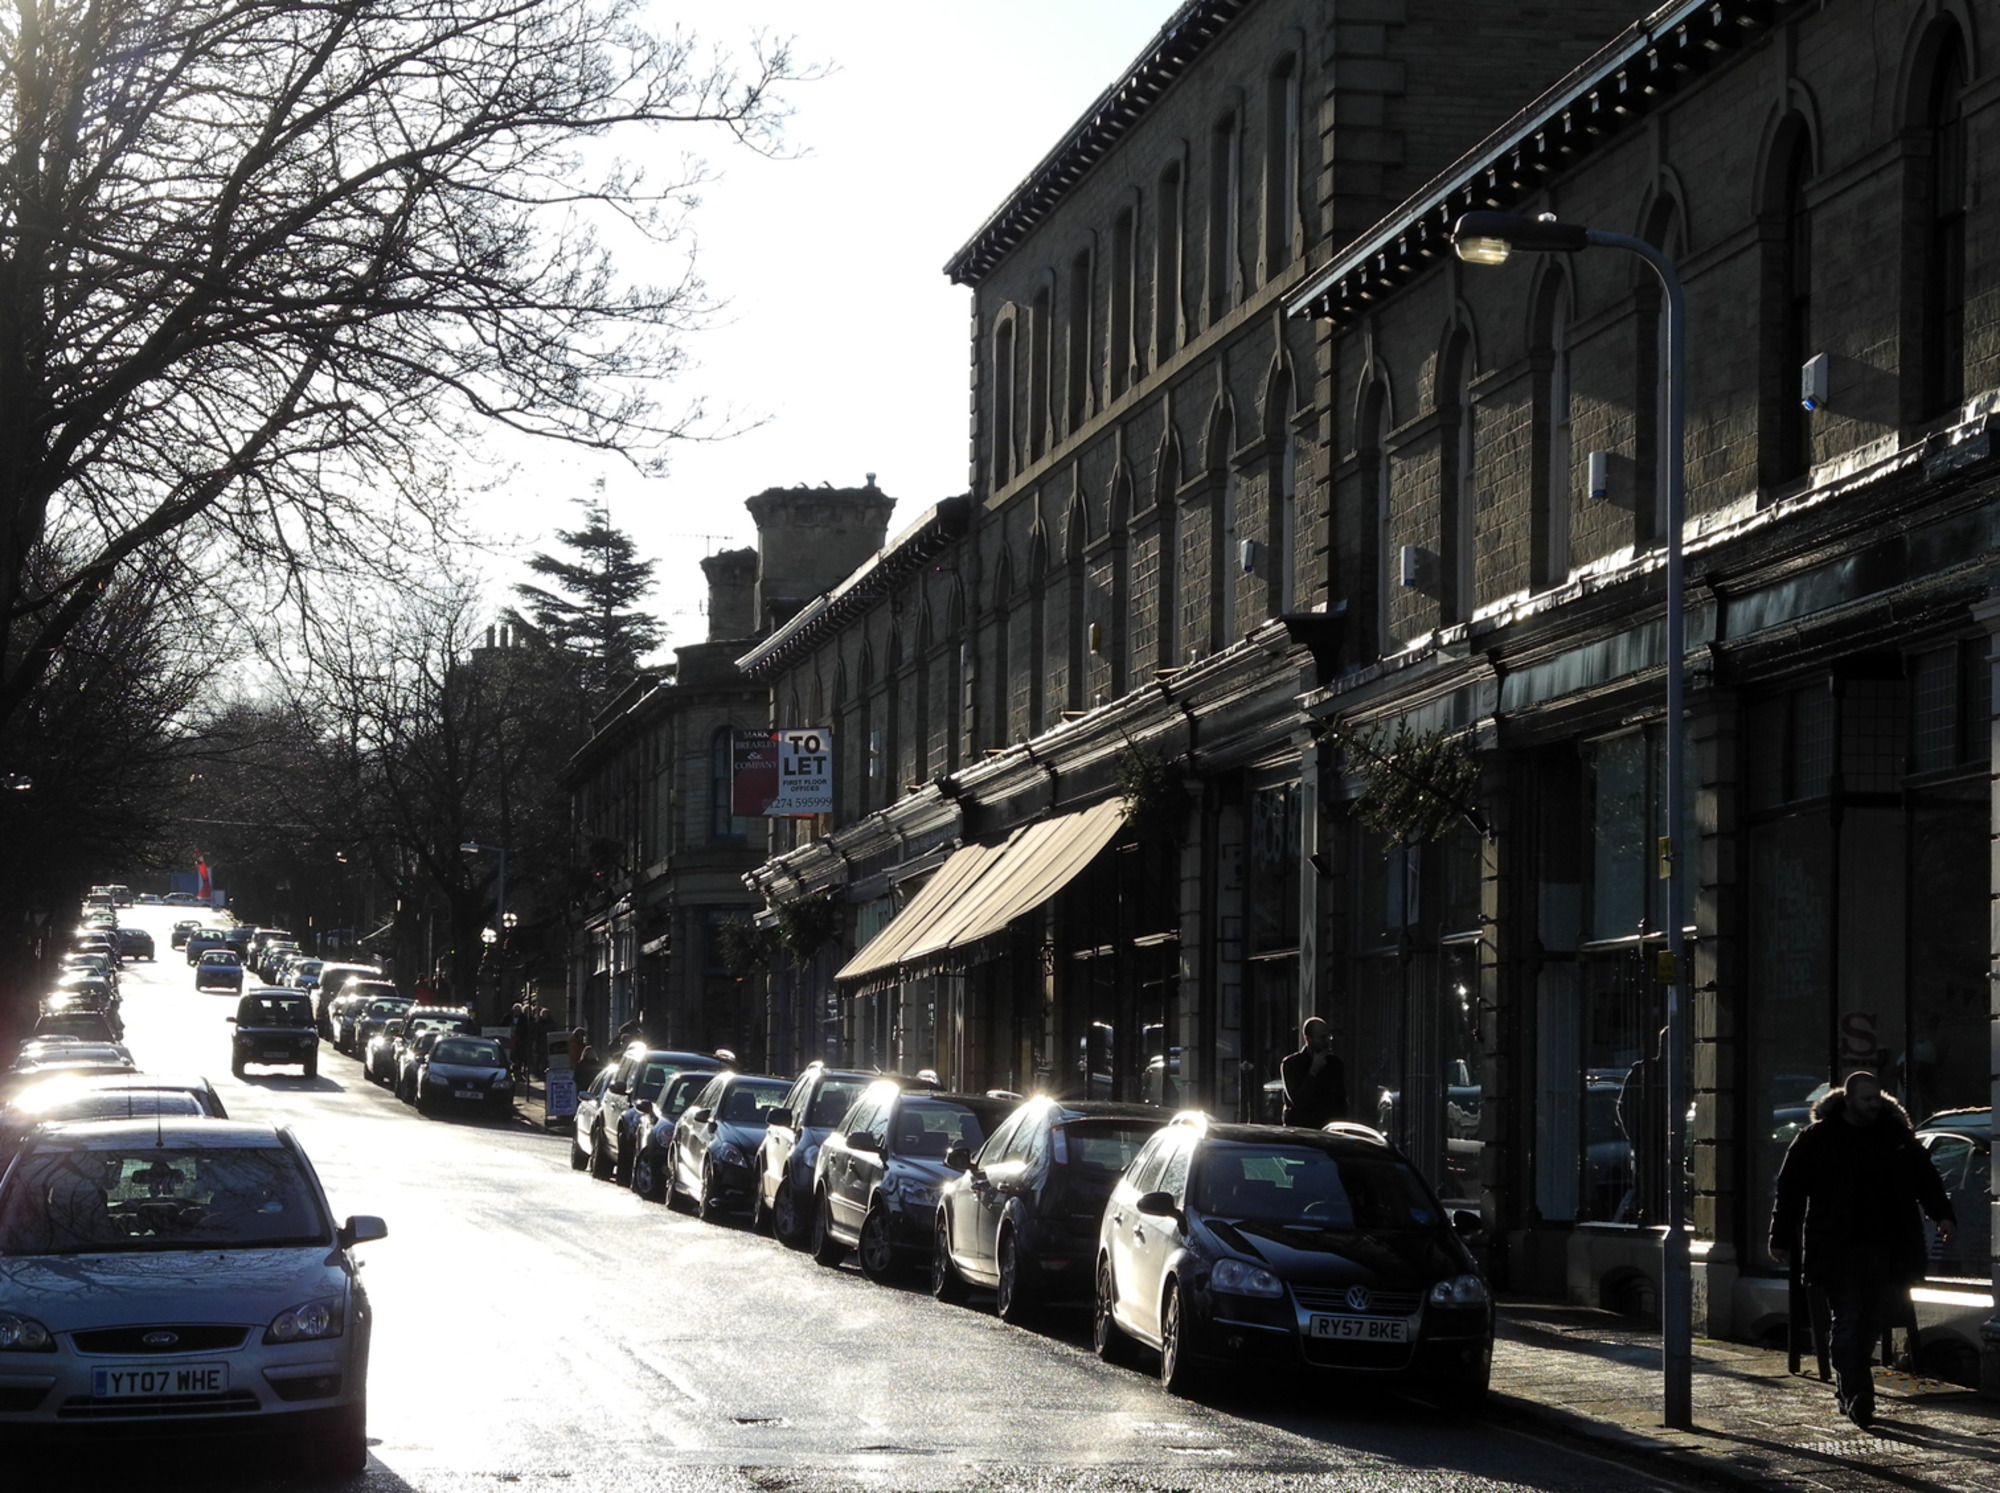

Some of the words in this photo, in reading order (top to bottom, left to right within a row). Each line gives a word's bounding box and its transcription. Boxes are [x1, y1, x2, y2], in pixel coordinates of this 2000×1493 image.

[735, 740, 777, 749] BREARLEY
[789, 735, 820, 754] TO
[735, 761, 776, 769] COMPANY
[747, 751, 762, 760] &
[784, 756, 826, 775] LET
[795, 797, 832, 808] 595999
[1841, 1011, 1877, 1057] S
[1319, 1319, 1363, 1337] RY57
[1369, 1322, 1401, 1339] BKE
[111, 1371, 170, 1393] YT07
[177, 1370, 220, 1391] WHE
